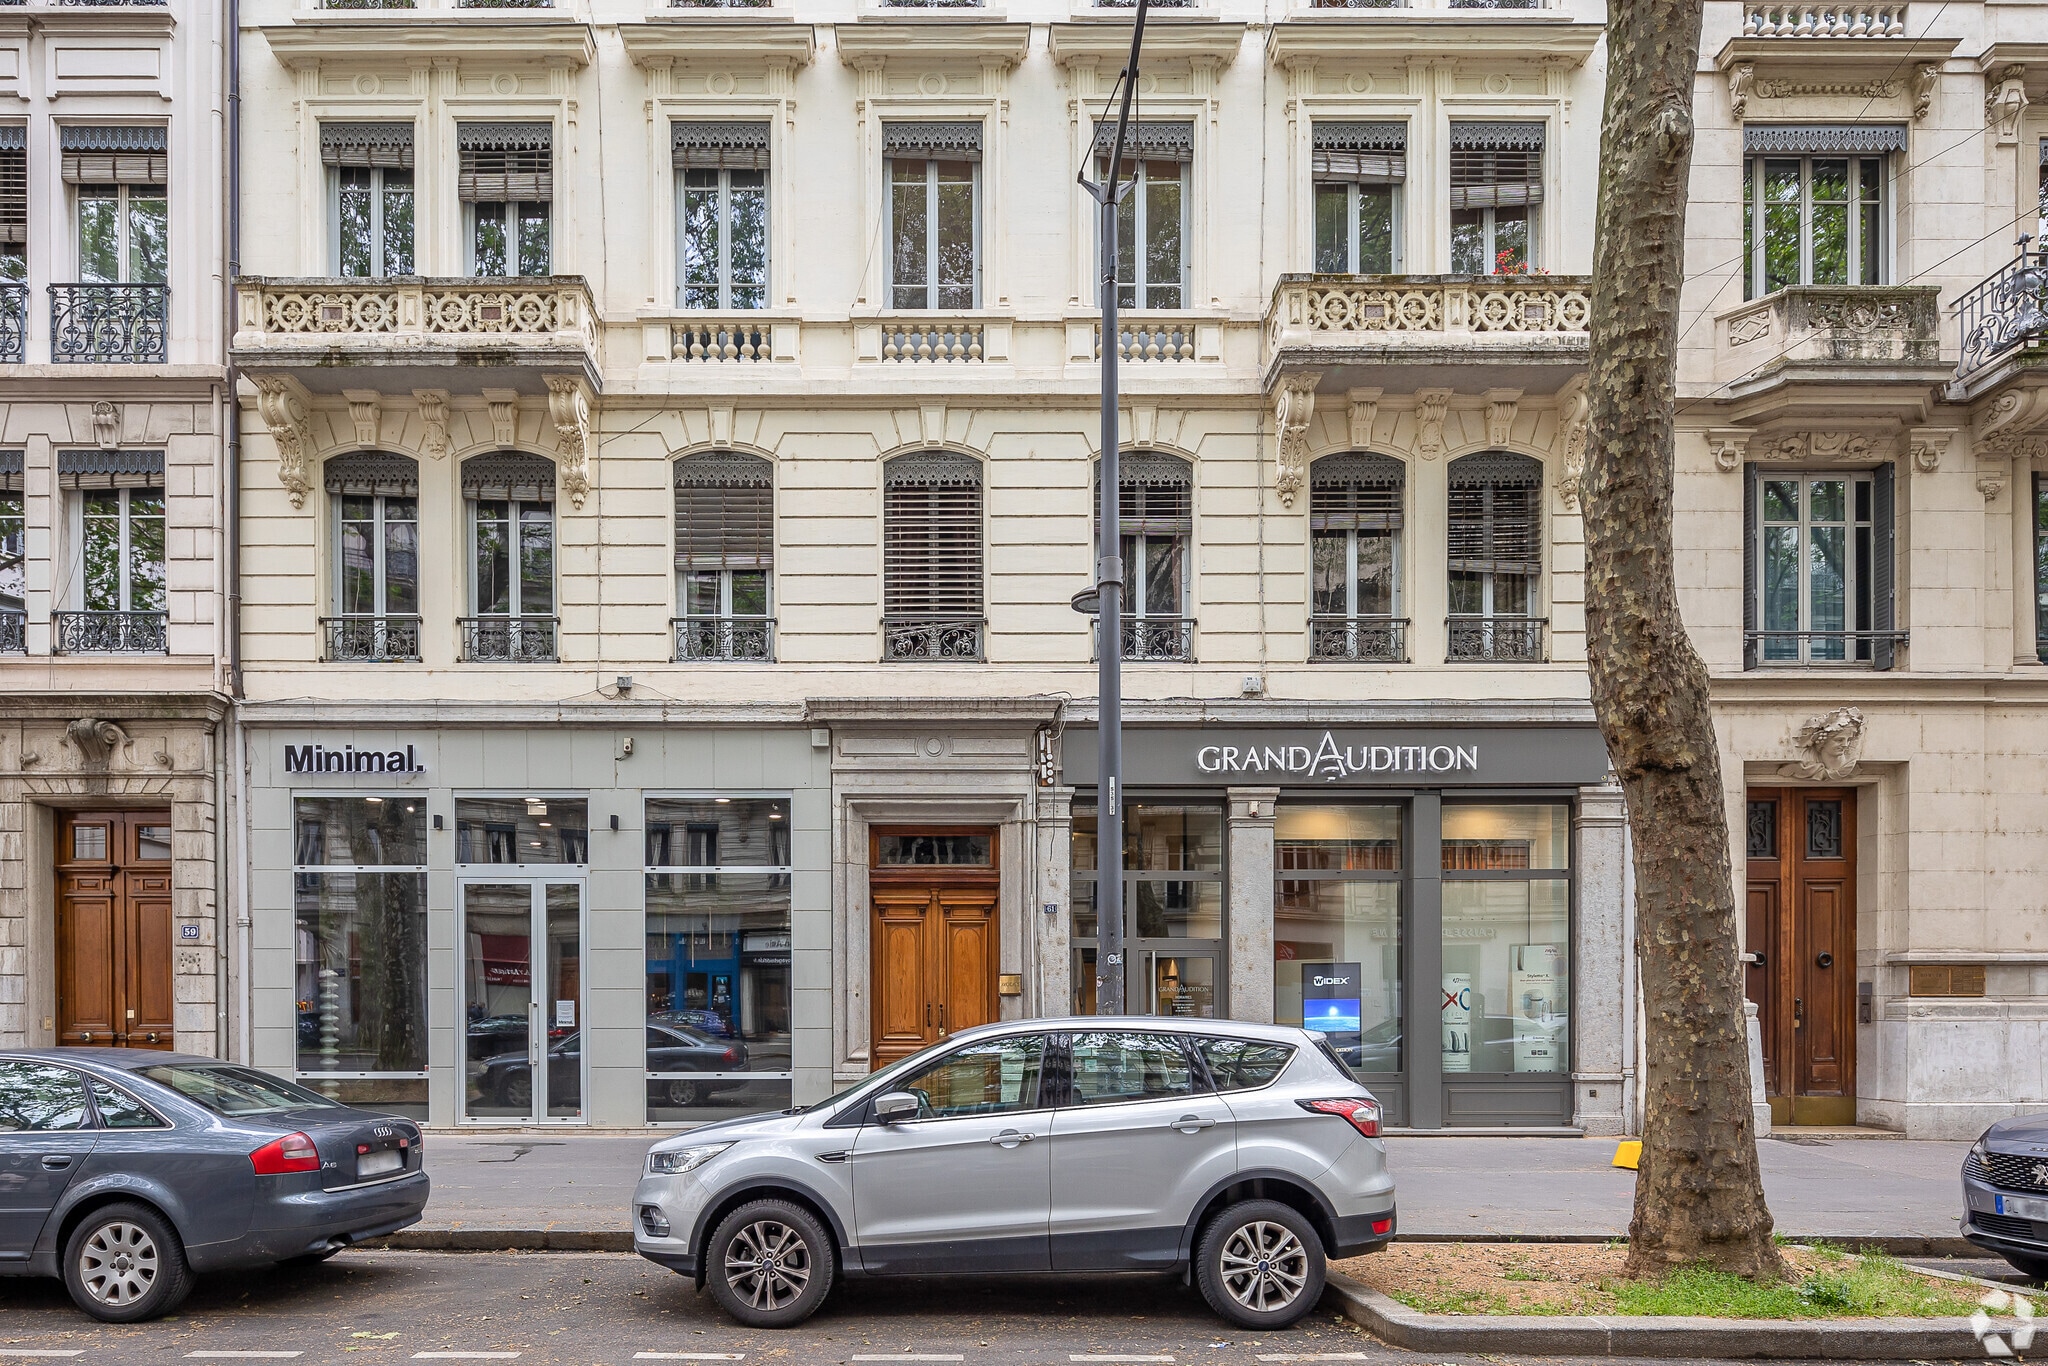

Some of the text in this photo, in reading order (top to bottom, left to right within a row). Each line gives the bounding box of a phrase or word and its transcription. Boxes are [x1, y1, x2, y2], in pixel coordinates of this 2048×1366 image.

[284, 744, 426, 773] Minimal.
[184, 927, 196, 936] 59
[321, 1161, 338, 1170] A6
